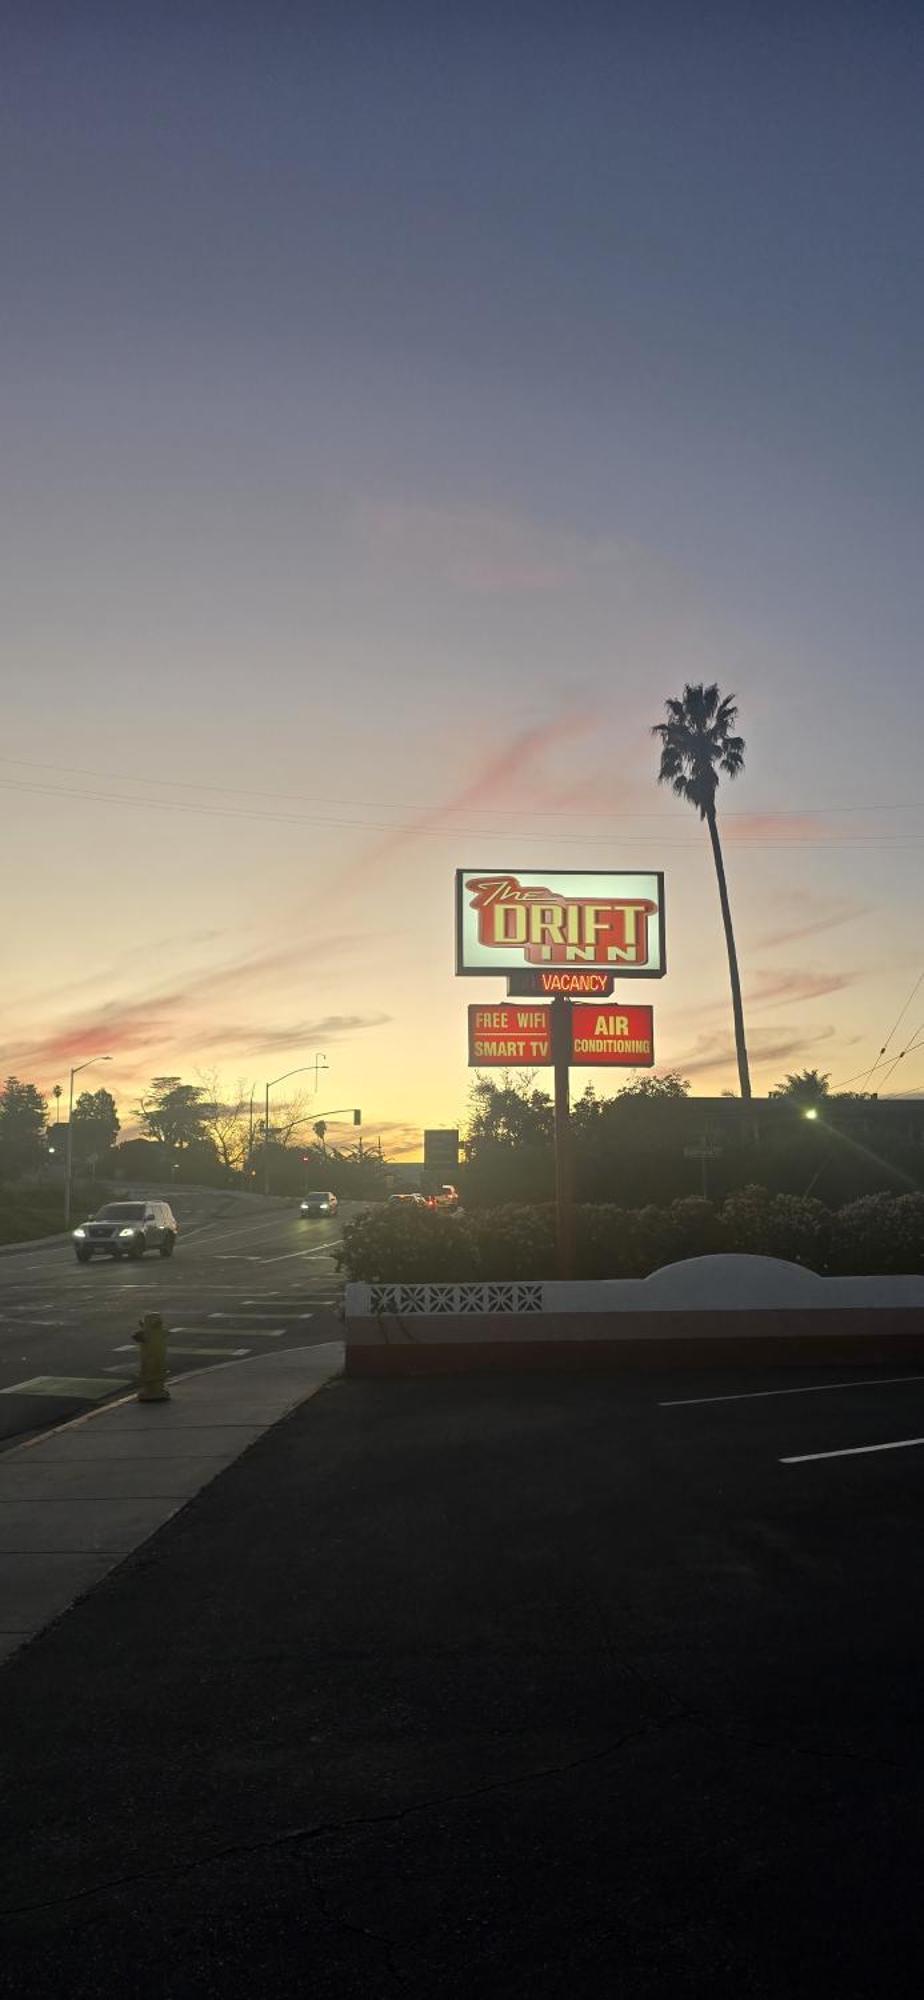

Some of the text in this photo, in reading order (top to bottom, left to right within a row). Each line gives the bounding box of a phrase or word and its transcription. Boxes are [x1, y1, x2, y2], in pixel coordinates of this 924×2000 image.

[478, 881, 559, 906] The
[495, 905, 645, 944] DRIFT
[542, 946, 636, 961] INN
[542, 974, 608, 991] VACANCY
[476, 1013, 546, 1028] FREE WIFI
[594, 1016, 629, 1036] AIR
[474, 1041, 548, 1057] SMART TV
[574, 1039, 650, 1054] CONDITIONING
